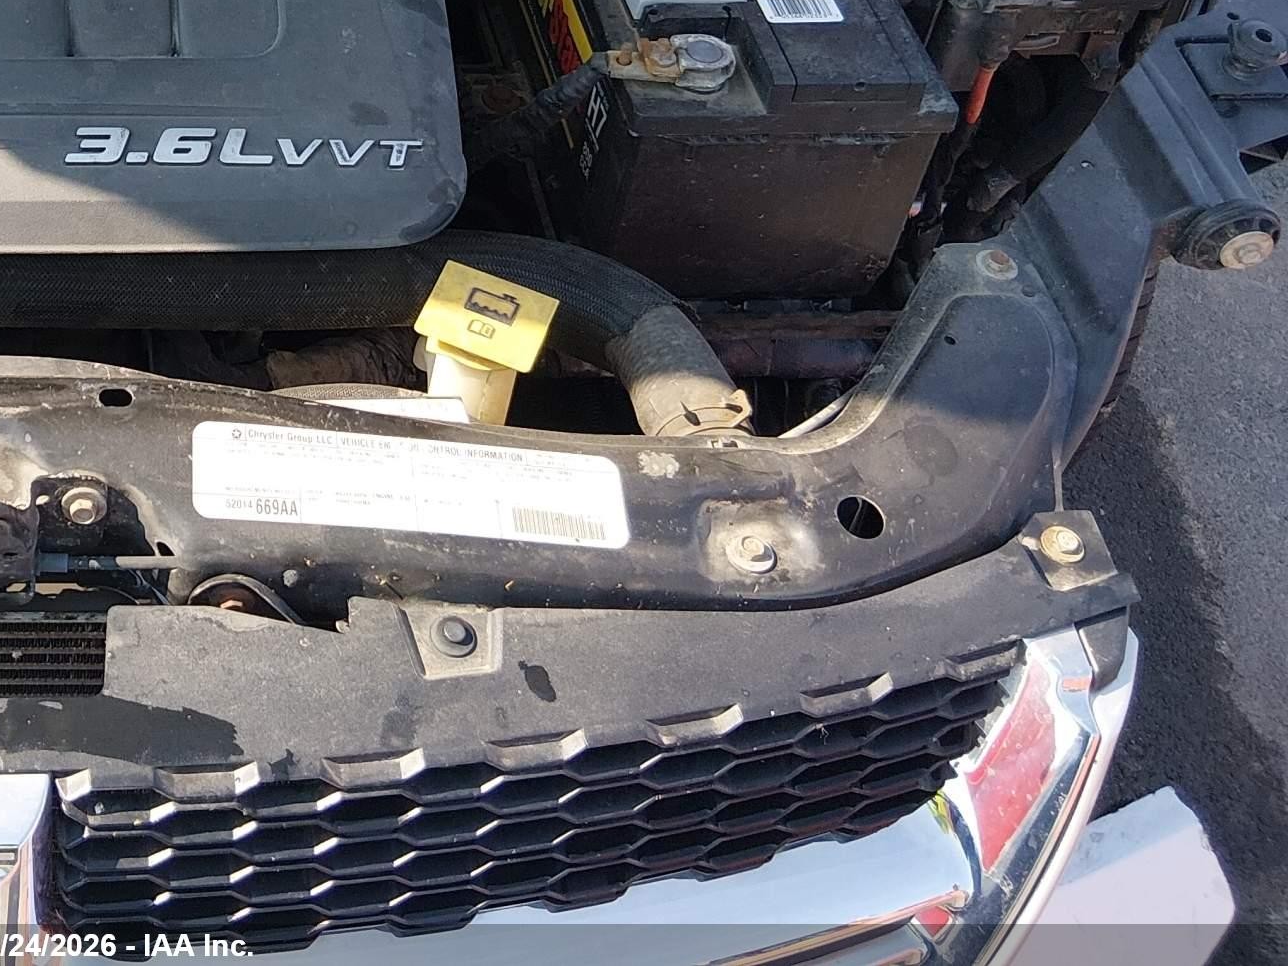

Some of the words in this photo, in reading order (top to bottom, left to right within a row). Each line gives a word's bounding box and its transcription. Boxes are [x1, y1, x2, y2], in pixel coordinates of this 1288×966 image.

[587, 85, 608, 138] H7
[277, 138, 424, 168] VVT
[248, 428, 284, 442] Chrysler
[287, 432, 313, 445] Group
[316, 435, 333, 446] LLC
[465, 447, 523, 462] INFORMATION
